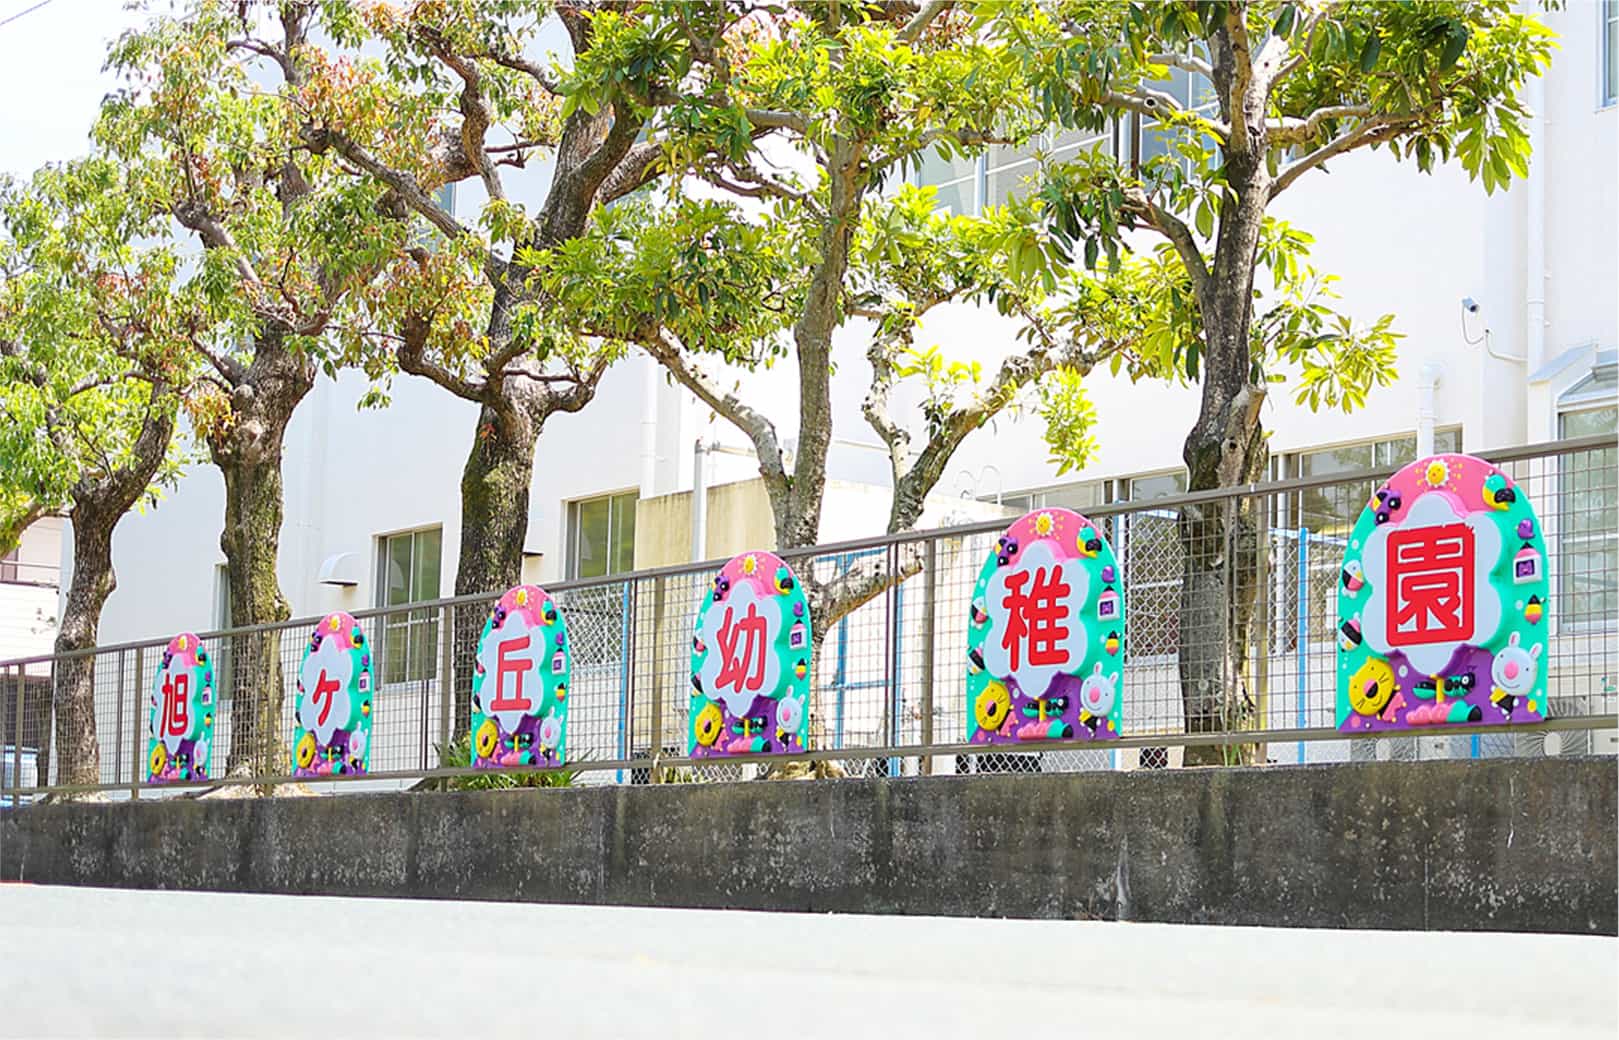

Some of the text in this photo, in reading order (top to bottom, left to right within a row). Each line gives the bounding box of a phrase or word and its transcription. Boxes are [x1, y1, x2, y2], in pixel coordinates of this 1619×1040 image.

[160, 674, 188, 736] 旭
[491, 636, 533, 712] 丘
[715, 603, 767, 693] 幼
[1001, 565, 1071, 672] 稚
[1386, 523, 1475, 647] 園
